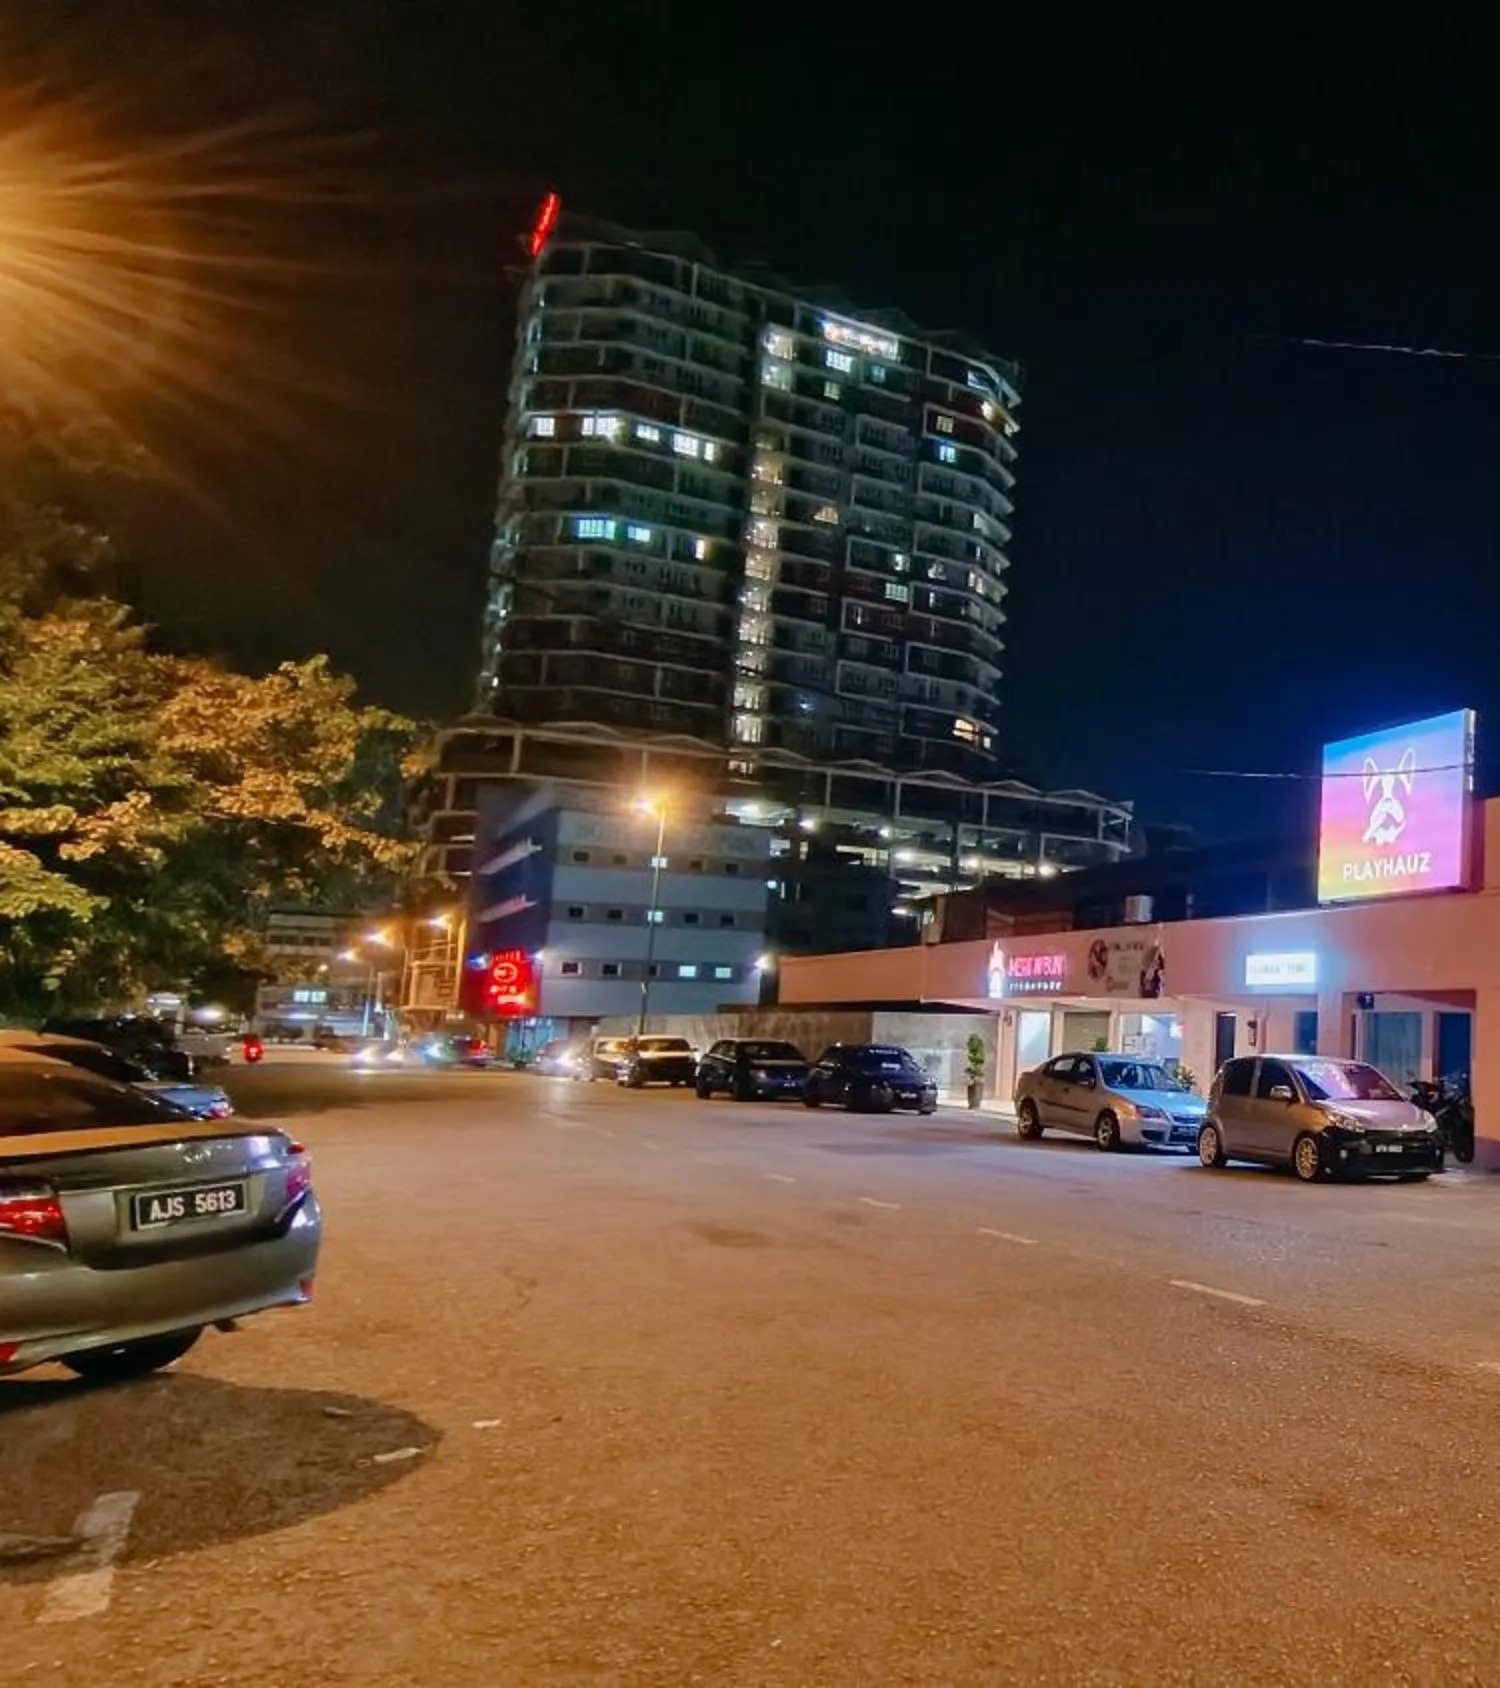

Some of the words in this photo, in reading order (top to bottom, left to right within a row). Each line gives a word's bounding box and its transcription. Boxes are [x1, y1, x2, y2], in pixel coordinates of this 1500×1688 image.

[1343, 852, 1431, 882] PLAYHAUZ
[150, 1197, 185, 1221] AJS
[195, 1190, 236, 1213] 5613
